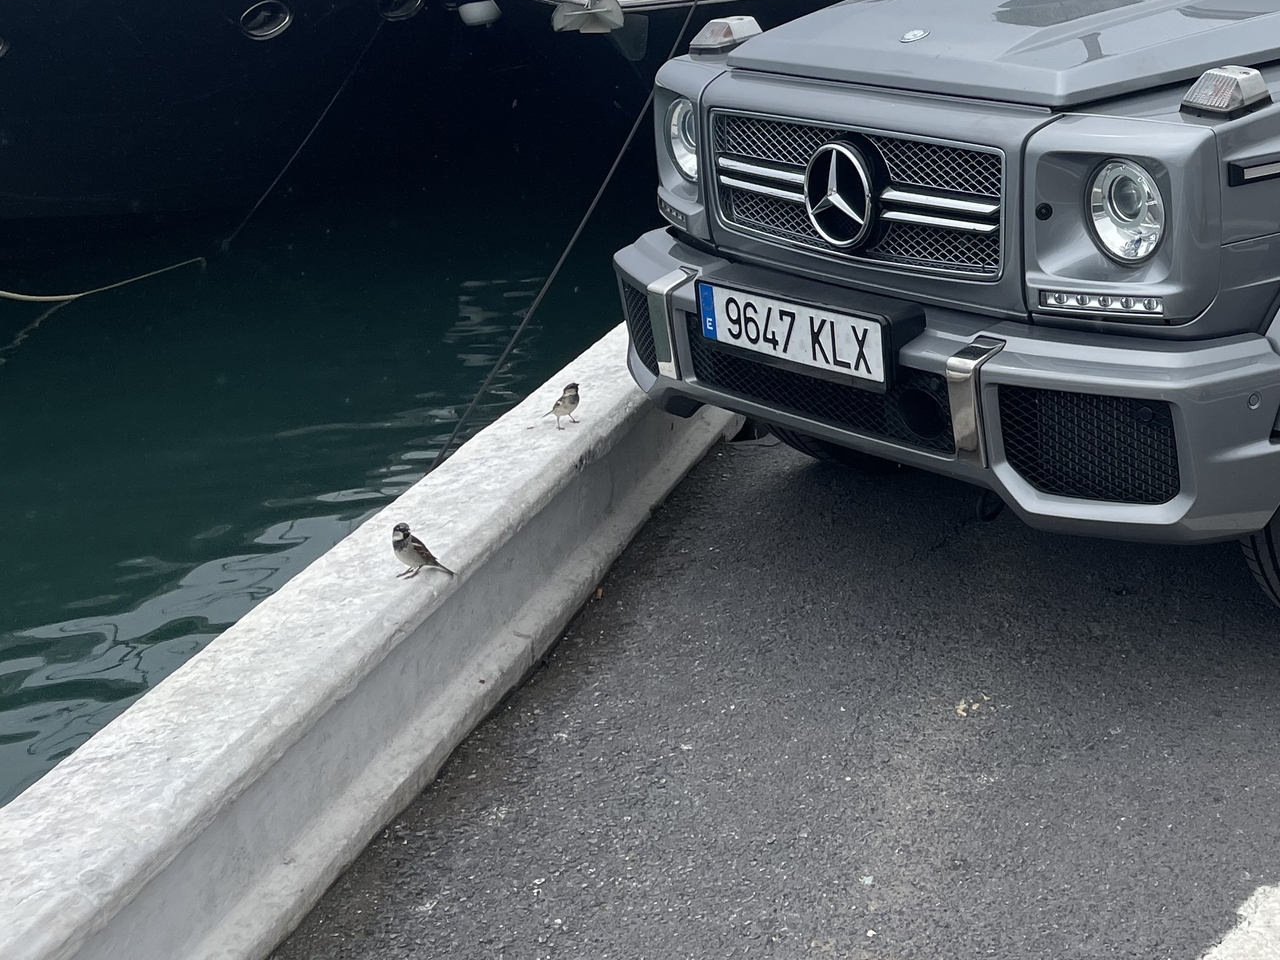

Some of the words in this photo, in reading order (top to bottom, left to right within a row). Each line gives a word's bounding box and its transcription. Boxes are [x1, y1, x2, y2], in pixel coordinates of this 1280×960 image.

[706, 317, 714, 331] E
[724, 296, 797, 354] 9647
[808, 314, 873, 375] KLX
